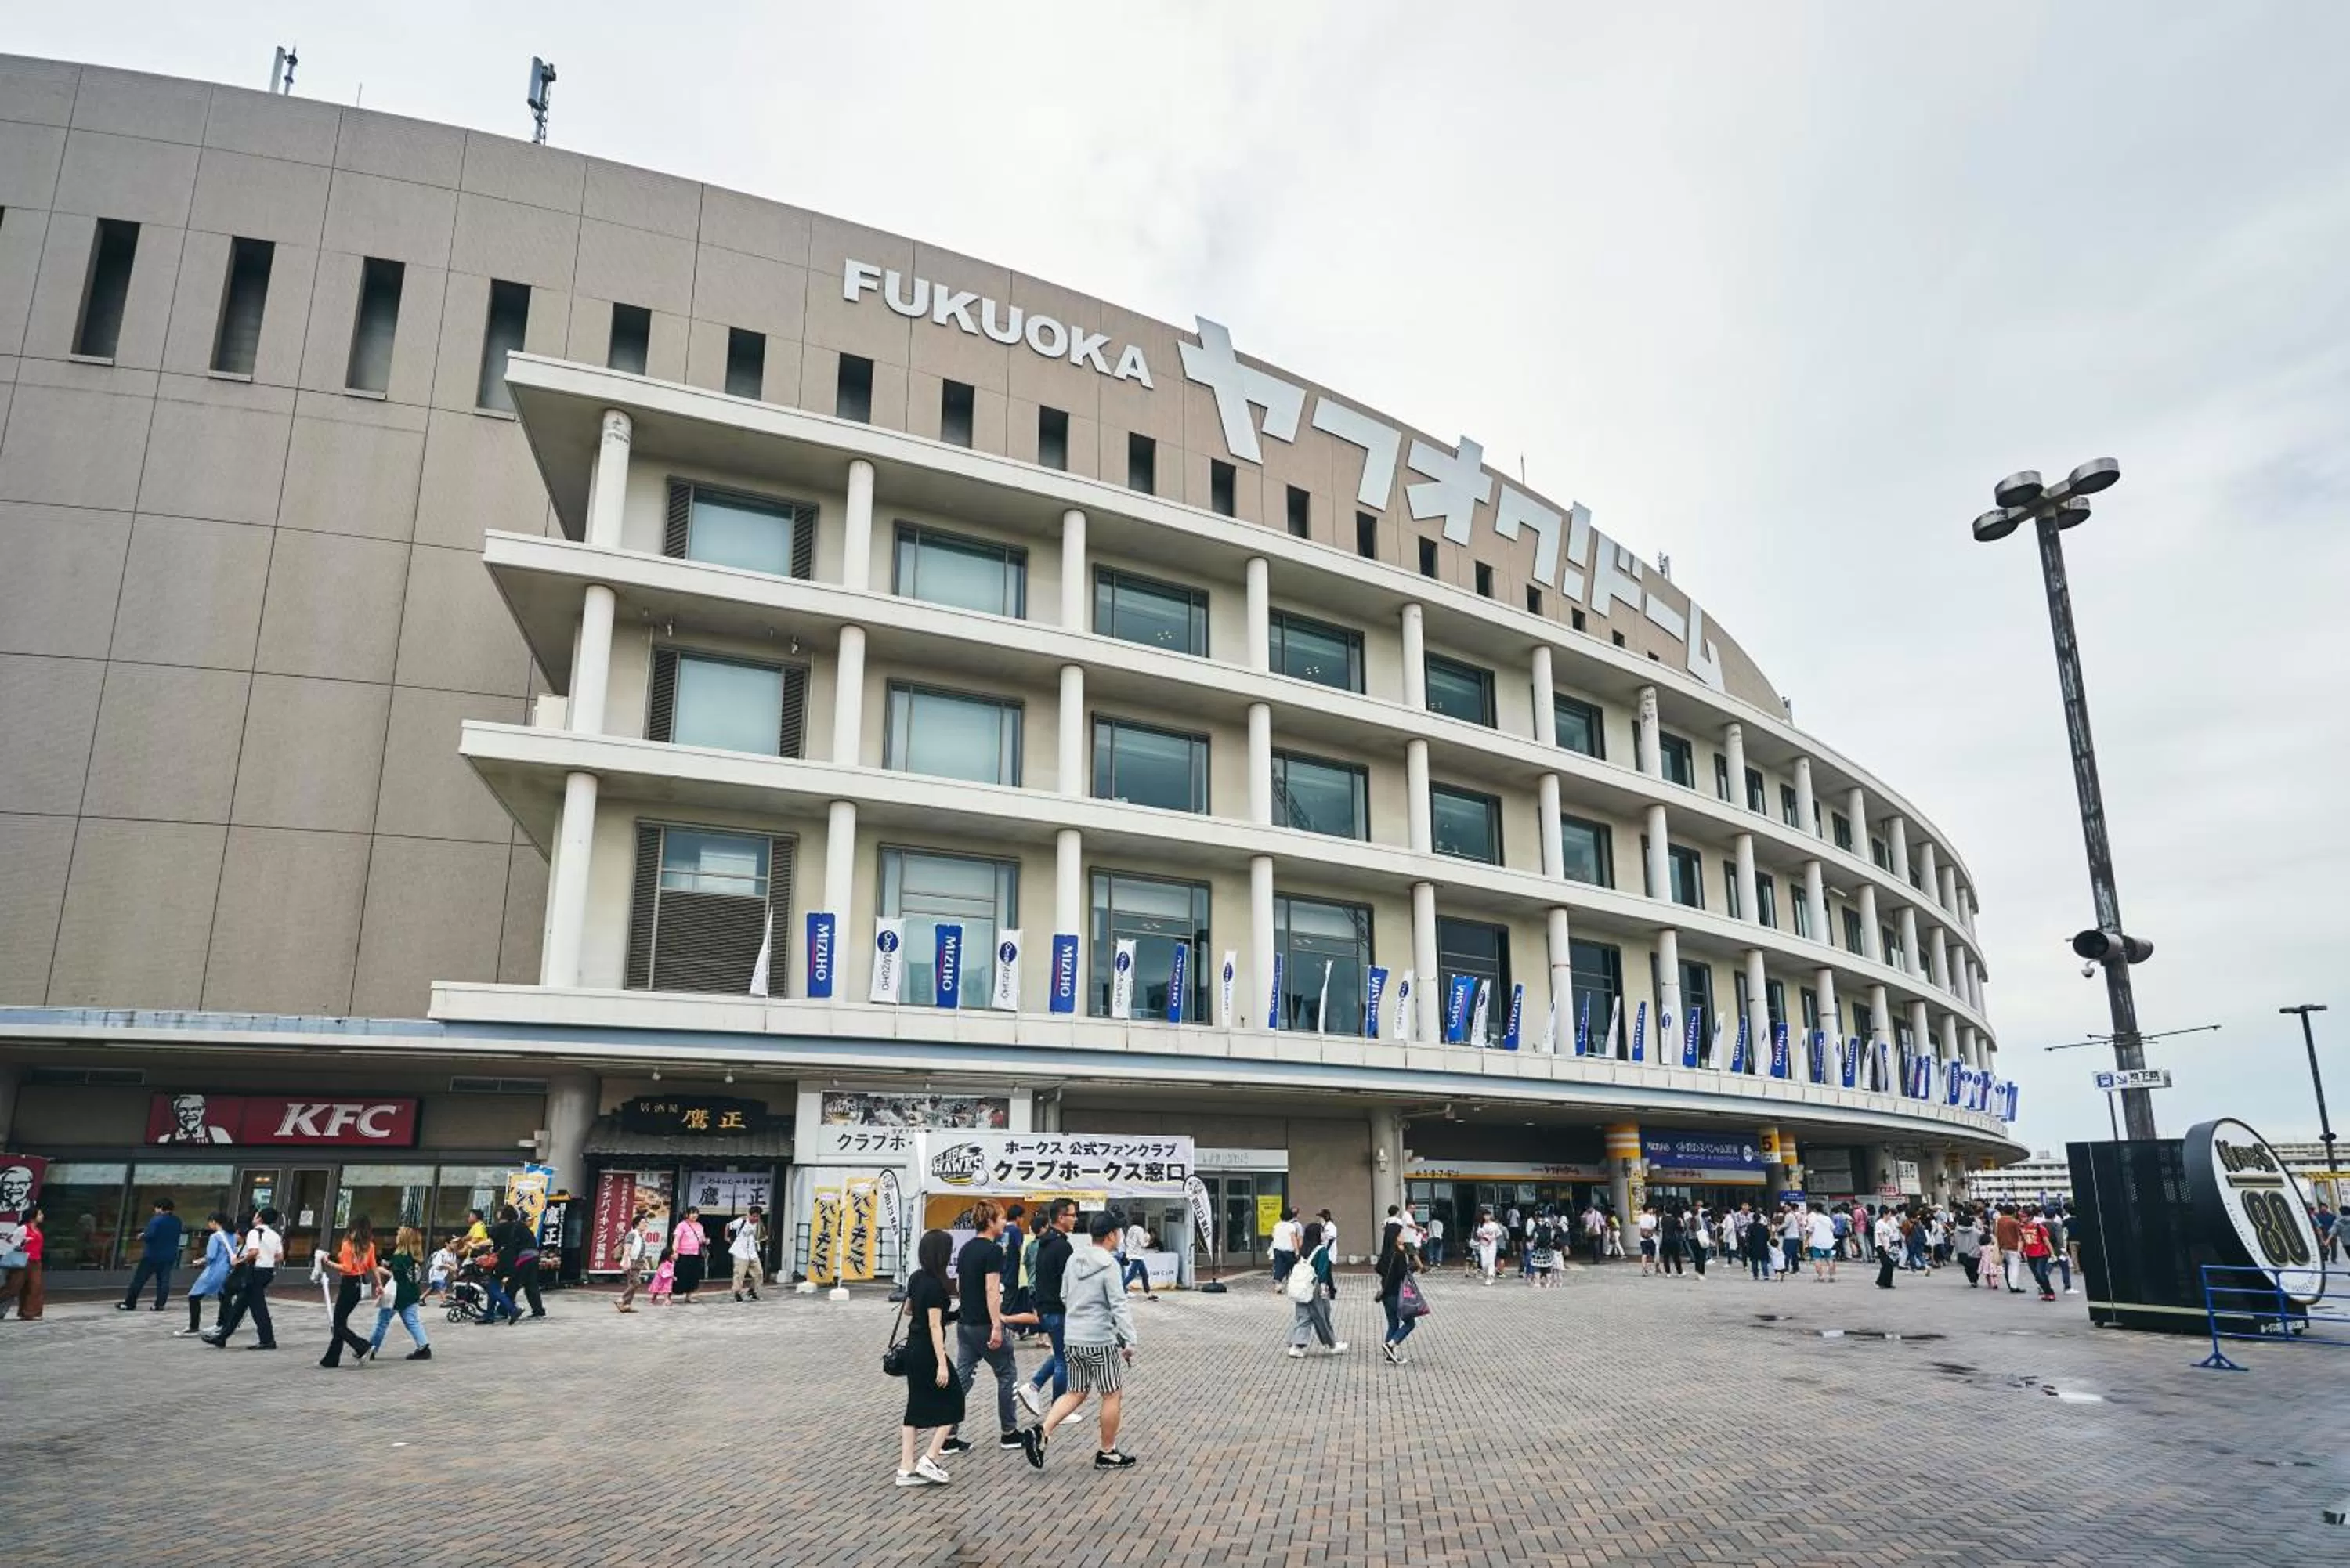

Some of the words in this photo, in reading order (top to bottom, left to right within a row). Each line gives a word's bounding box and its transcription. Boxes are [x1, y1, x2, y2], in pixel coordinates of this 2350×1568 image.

[842, 257, 1155, 391] FUKUOKA
[815, 923, 830, 981] MIZUHO
[883, 930, 894, 952] One
[880, 953, 893, 991] MIZUHO
[942, 935, 956, 992] MIZUHO
[1060, 942, 1074, 998] MIZUHO
[273, 1103, 398, 1138] KFC
[681, 1108, 747, 1130] 鷹正
[837, 1133, 913, 1151] クラブホ
[1005, 1140, 1064, 1154] ホークス
[1069, 1142, 1177, 1158] 公式ファンクラブ
[1762, 1135, 1772, 1151] 5
[993, 1159, 1186, 1182] クラブホークス窓口
[2240, 1189, 2312, 1267] 80
